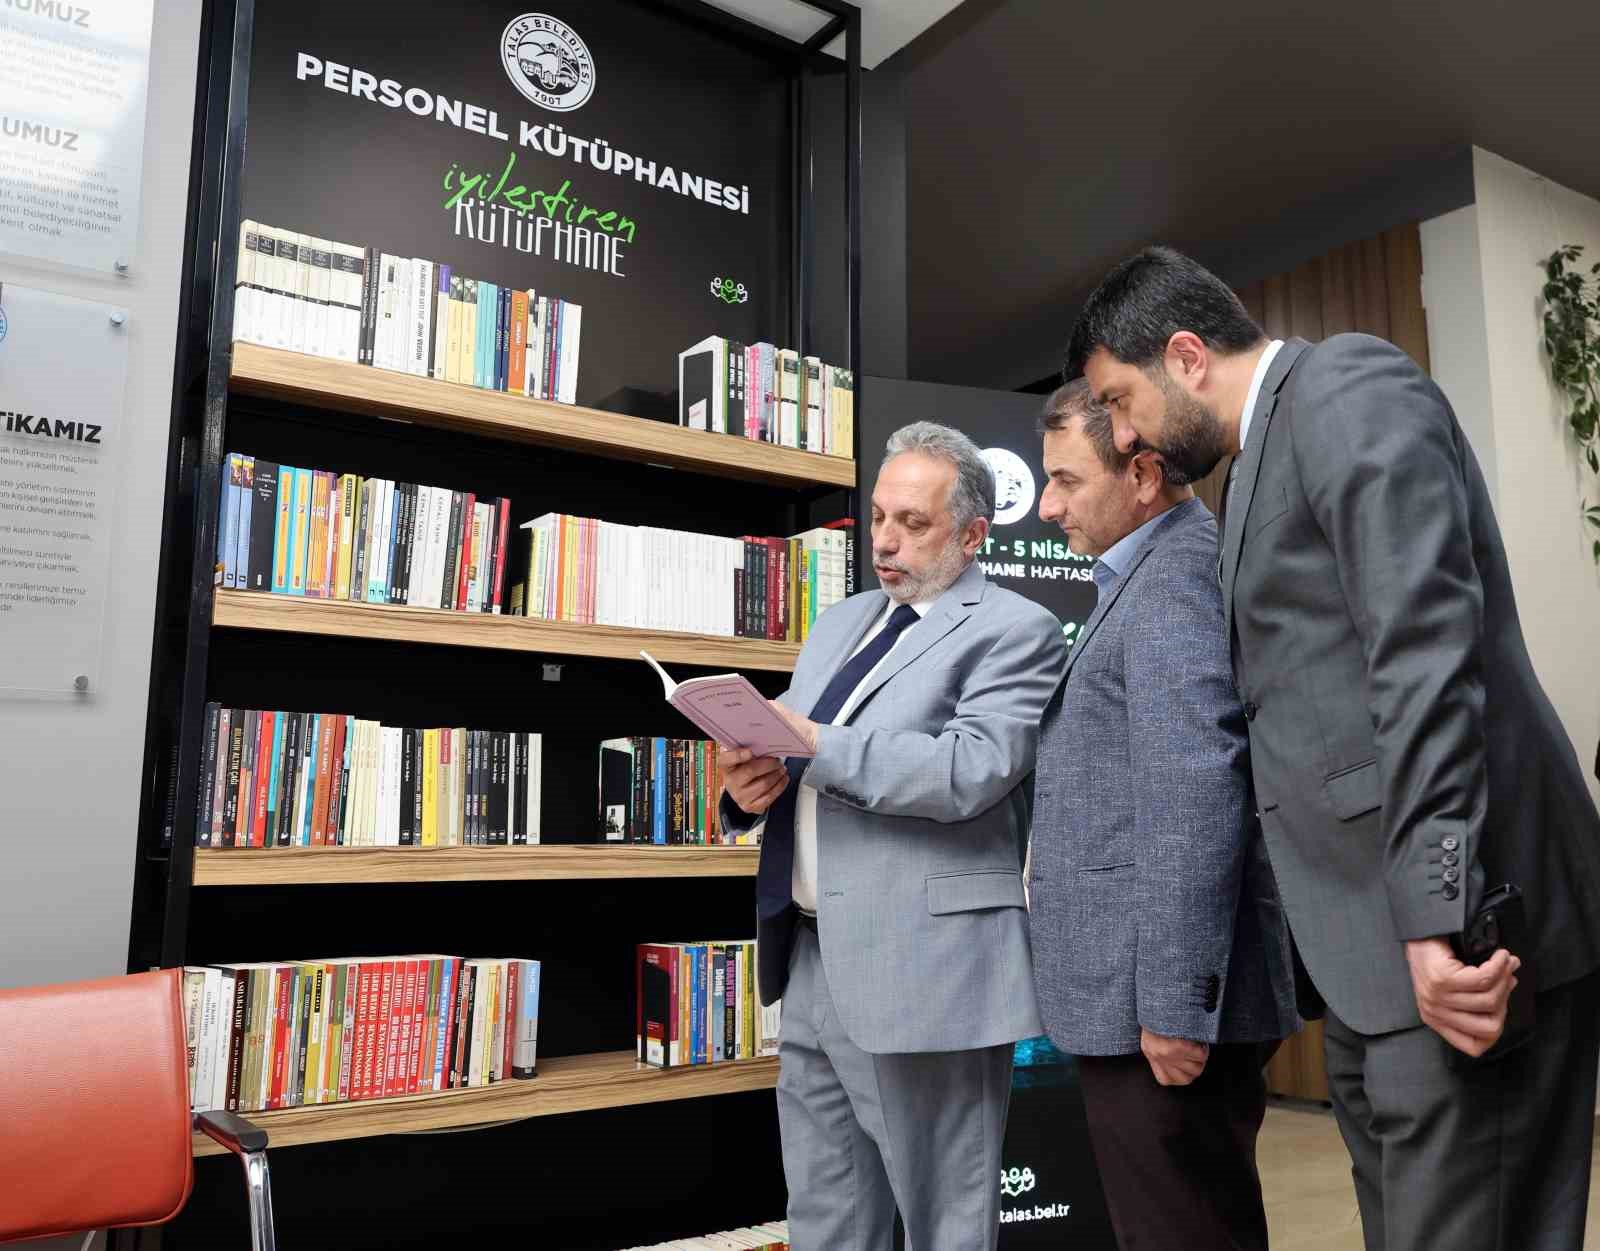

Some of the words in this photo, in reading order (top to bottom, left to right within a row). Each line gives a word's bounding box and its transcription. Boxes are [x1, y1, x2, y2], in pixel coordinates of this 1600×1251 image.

[5, 0, 91, 29] UMUZ
[507, 21, 529, 59] TALAS
[533, 90, 561, 106] 1907
[296, 52, 509, 142] PERSONEL
[519, 120, 750, 216] KÜTÜPHANESİ
[443, 151, 637, 244] iyileştiren
[454, 196, 626, 278] KÜTÜPHANE
[1013, 540, 1026, 557] 5
[978, 561, 1026, 578] HANE
[1030, 565, 1094, 582] HAFTASI
